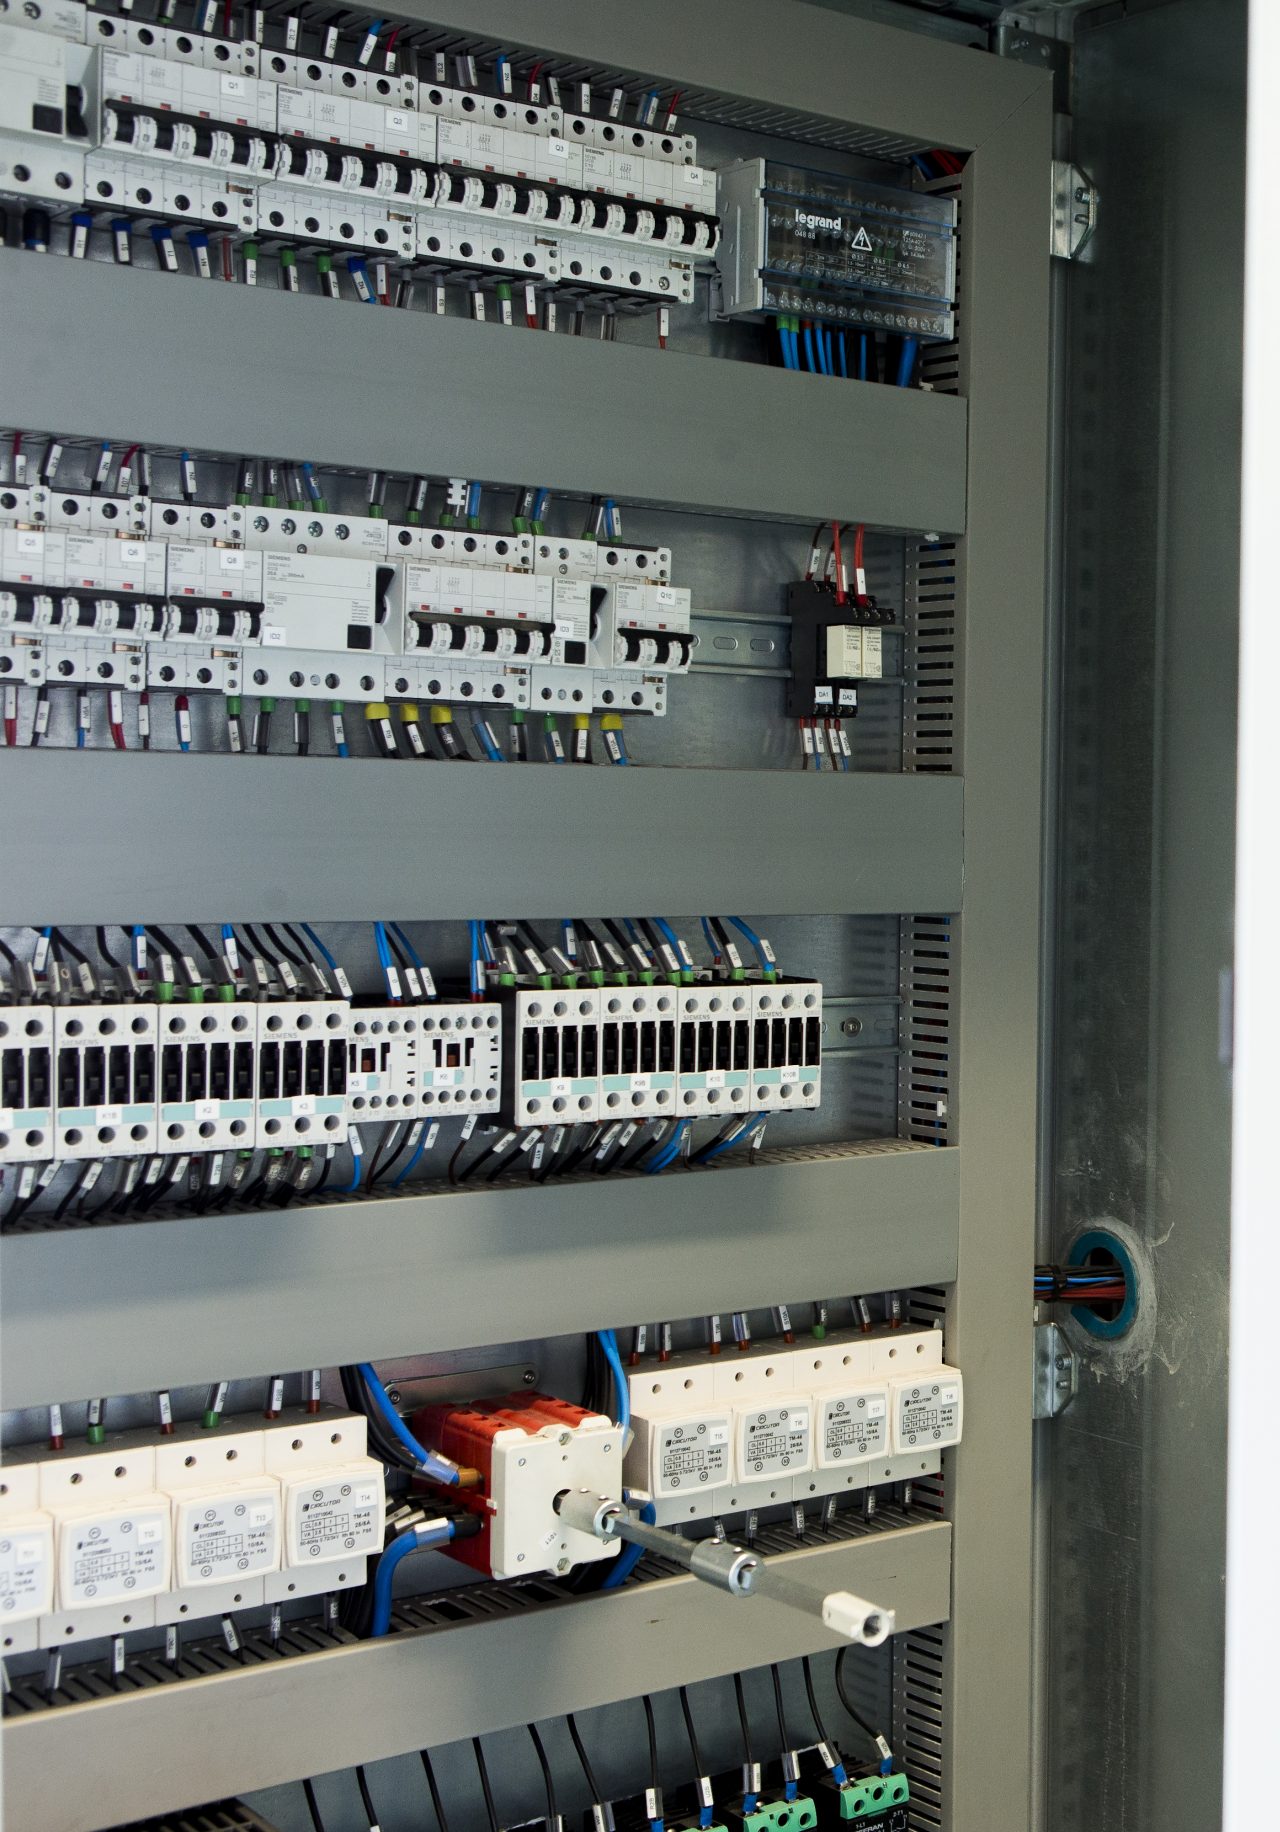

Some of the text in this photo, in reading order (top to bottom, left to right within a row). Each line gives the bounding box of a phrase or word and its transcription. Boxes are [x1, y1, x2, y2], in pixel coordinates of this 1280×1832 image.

[794, 209, 842, 230] legrand
[794, 230, 816, 240] 048 88
